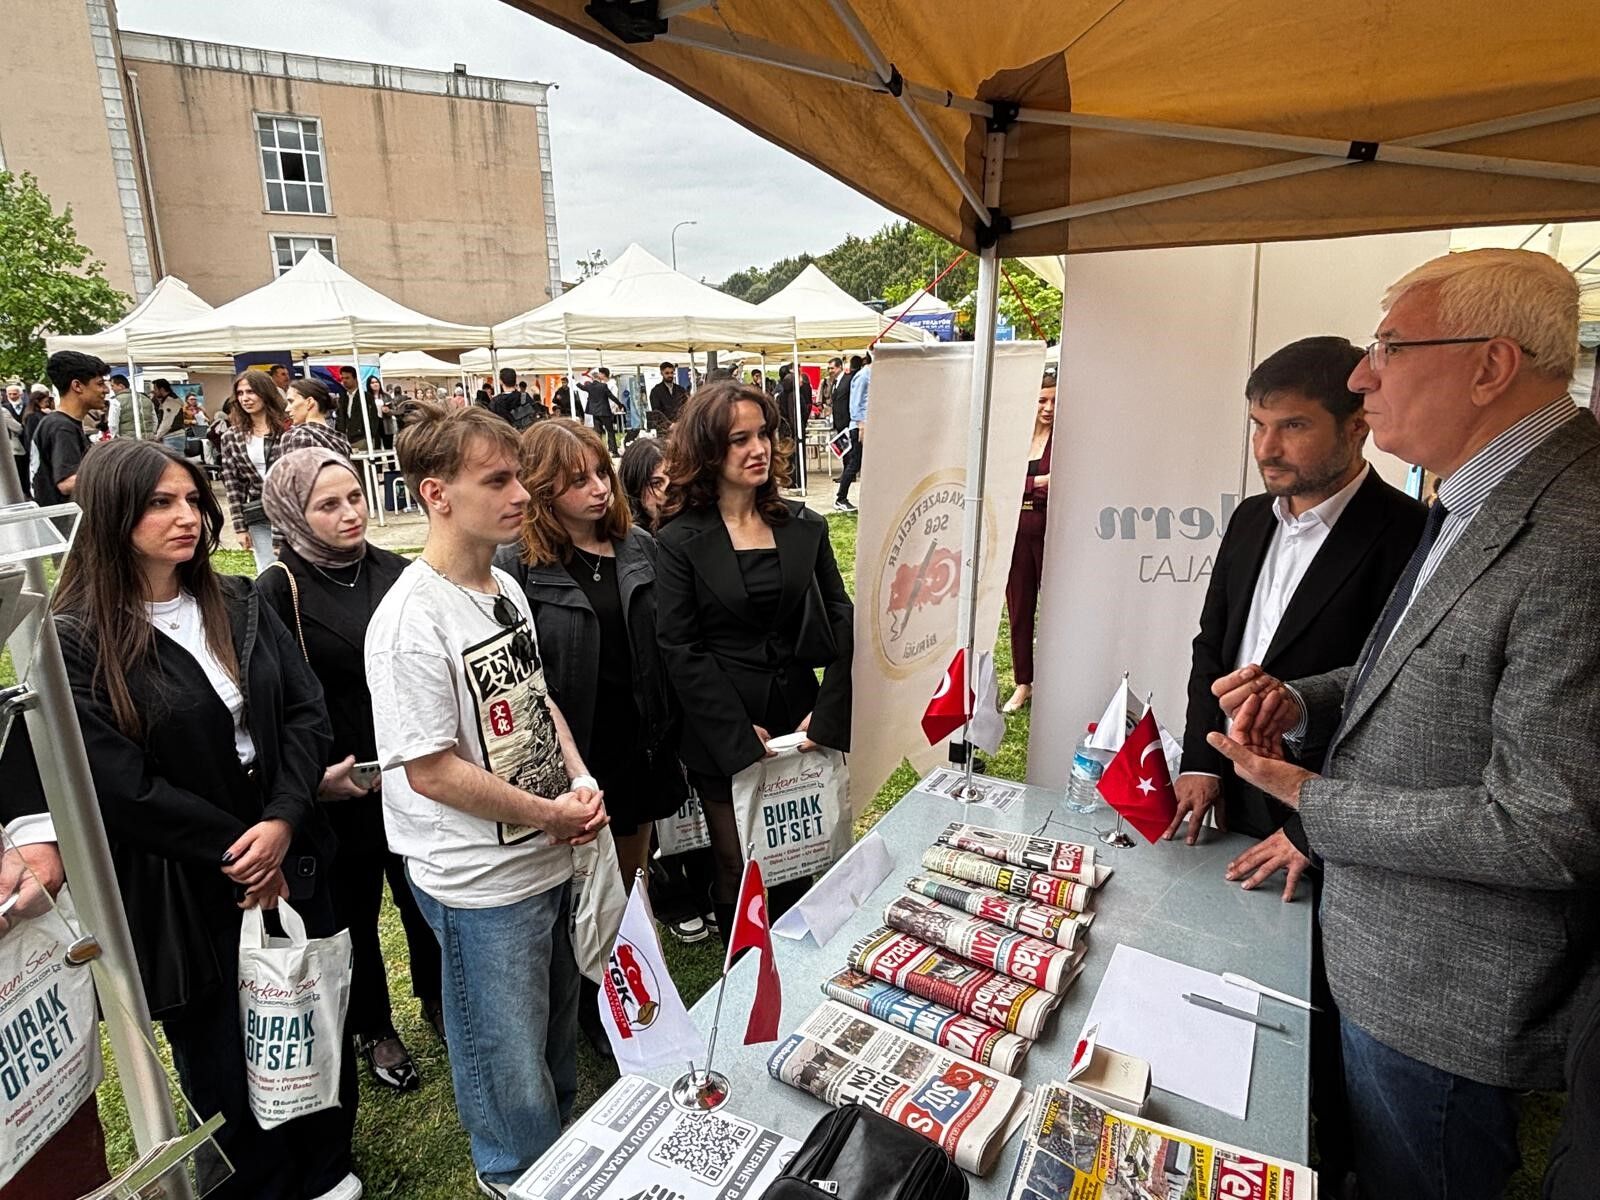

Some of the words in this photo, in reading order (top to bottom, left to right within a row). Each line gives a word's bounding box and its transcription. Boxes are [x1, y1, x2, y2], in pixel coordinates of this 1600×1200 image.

[763, 793, 823, 827] BURAK
[766, 815, 823, 849] OFSET
[609, 951, 635, 1008] TGK
[248, 1008, 315, 1041] BURAK
[1, 1013, 74, 1101] OFSET
[247, 1035, 314, 1070] OFSET
[847, 1065, 880, 1091] İÇİN
[653, 1101, 671, 1117] QR
[918, 1080, 960, 1111] SÖZ
[631, 1112, 660, 1145] KODU
[562, 1162, 587, 1186] PAROLA
[582, 1145, 636, 1199] TARATINIZ
